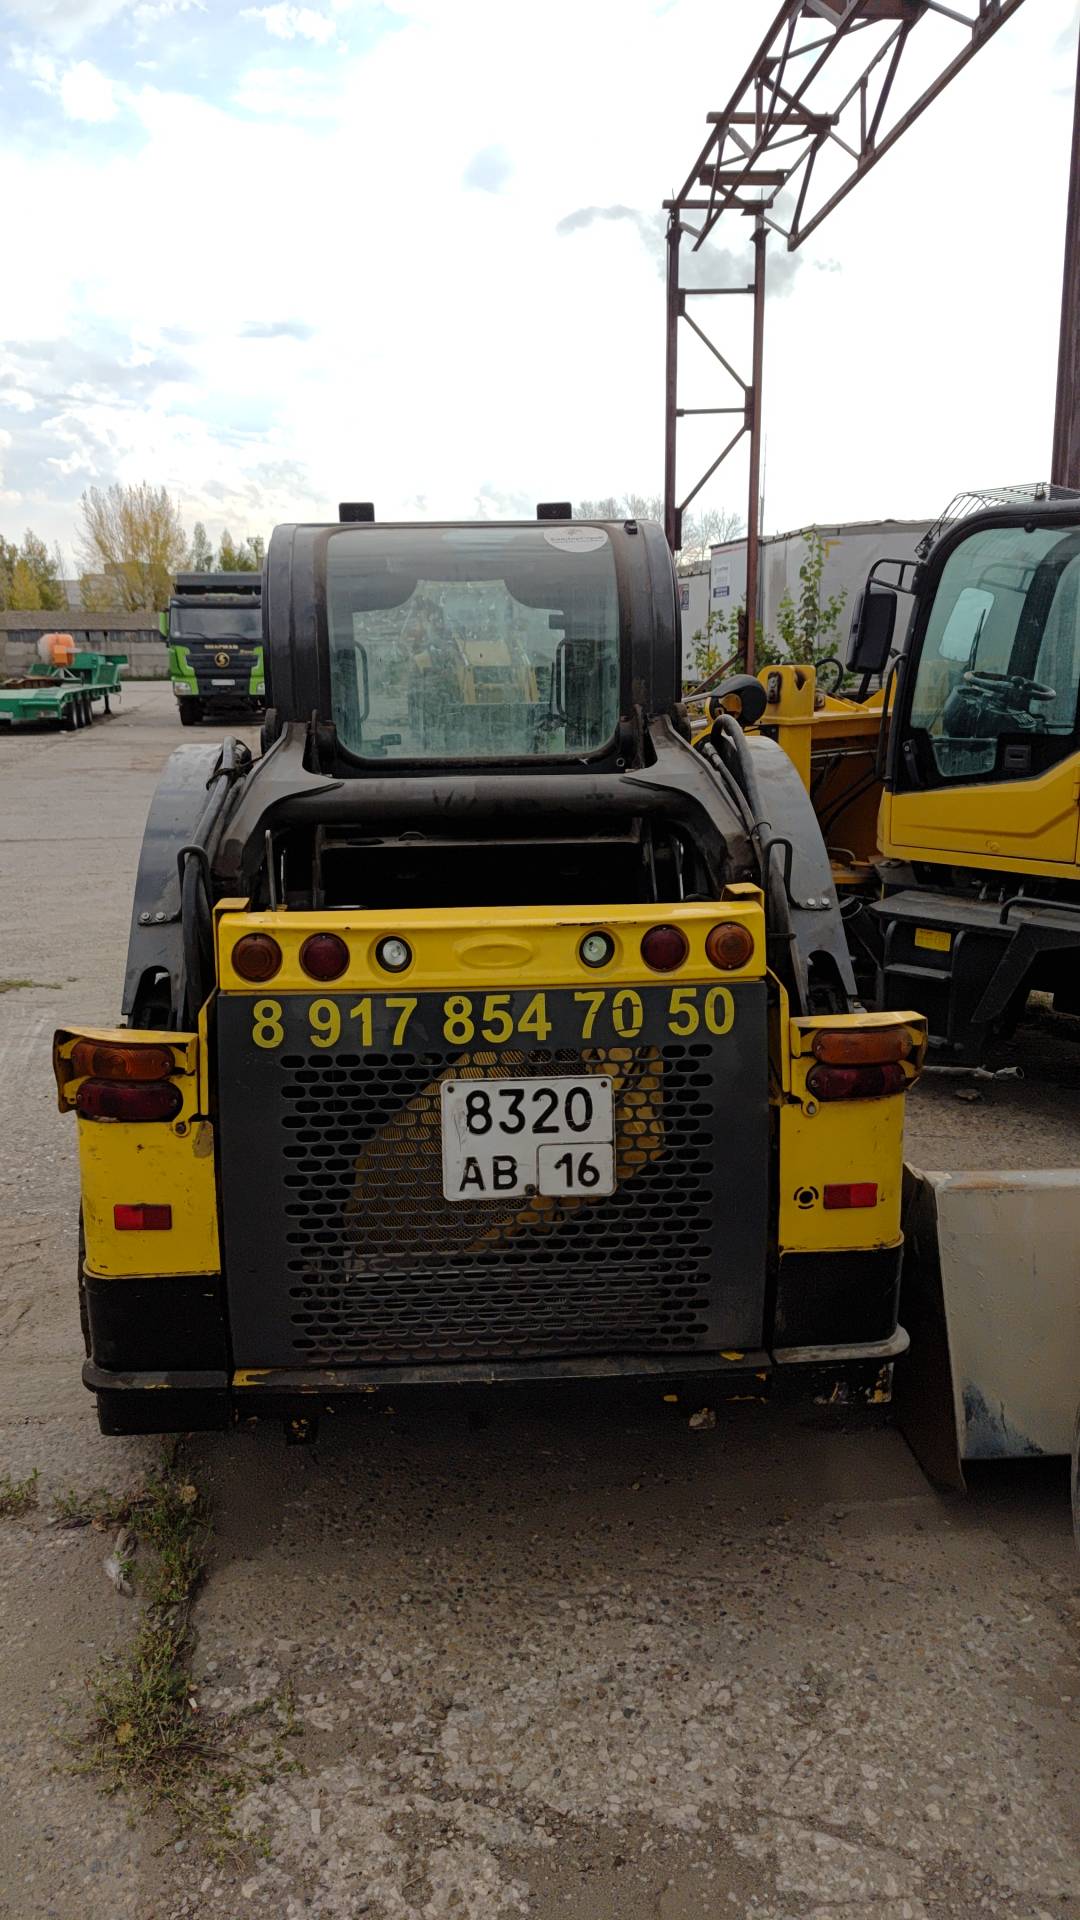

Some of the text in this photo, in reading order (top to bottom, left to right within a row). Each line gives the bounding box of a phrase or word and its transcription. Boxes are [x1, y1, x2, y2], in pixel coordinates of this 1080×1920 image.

[252, 986, 735, 1049] 8 917 854 70 50
[465, 1086, 593, 1135] 8320
[554, 1152, 600, 1188] 16
